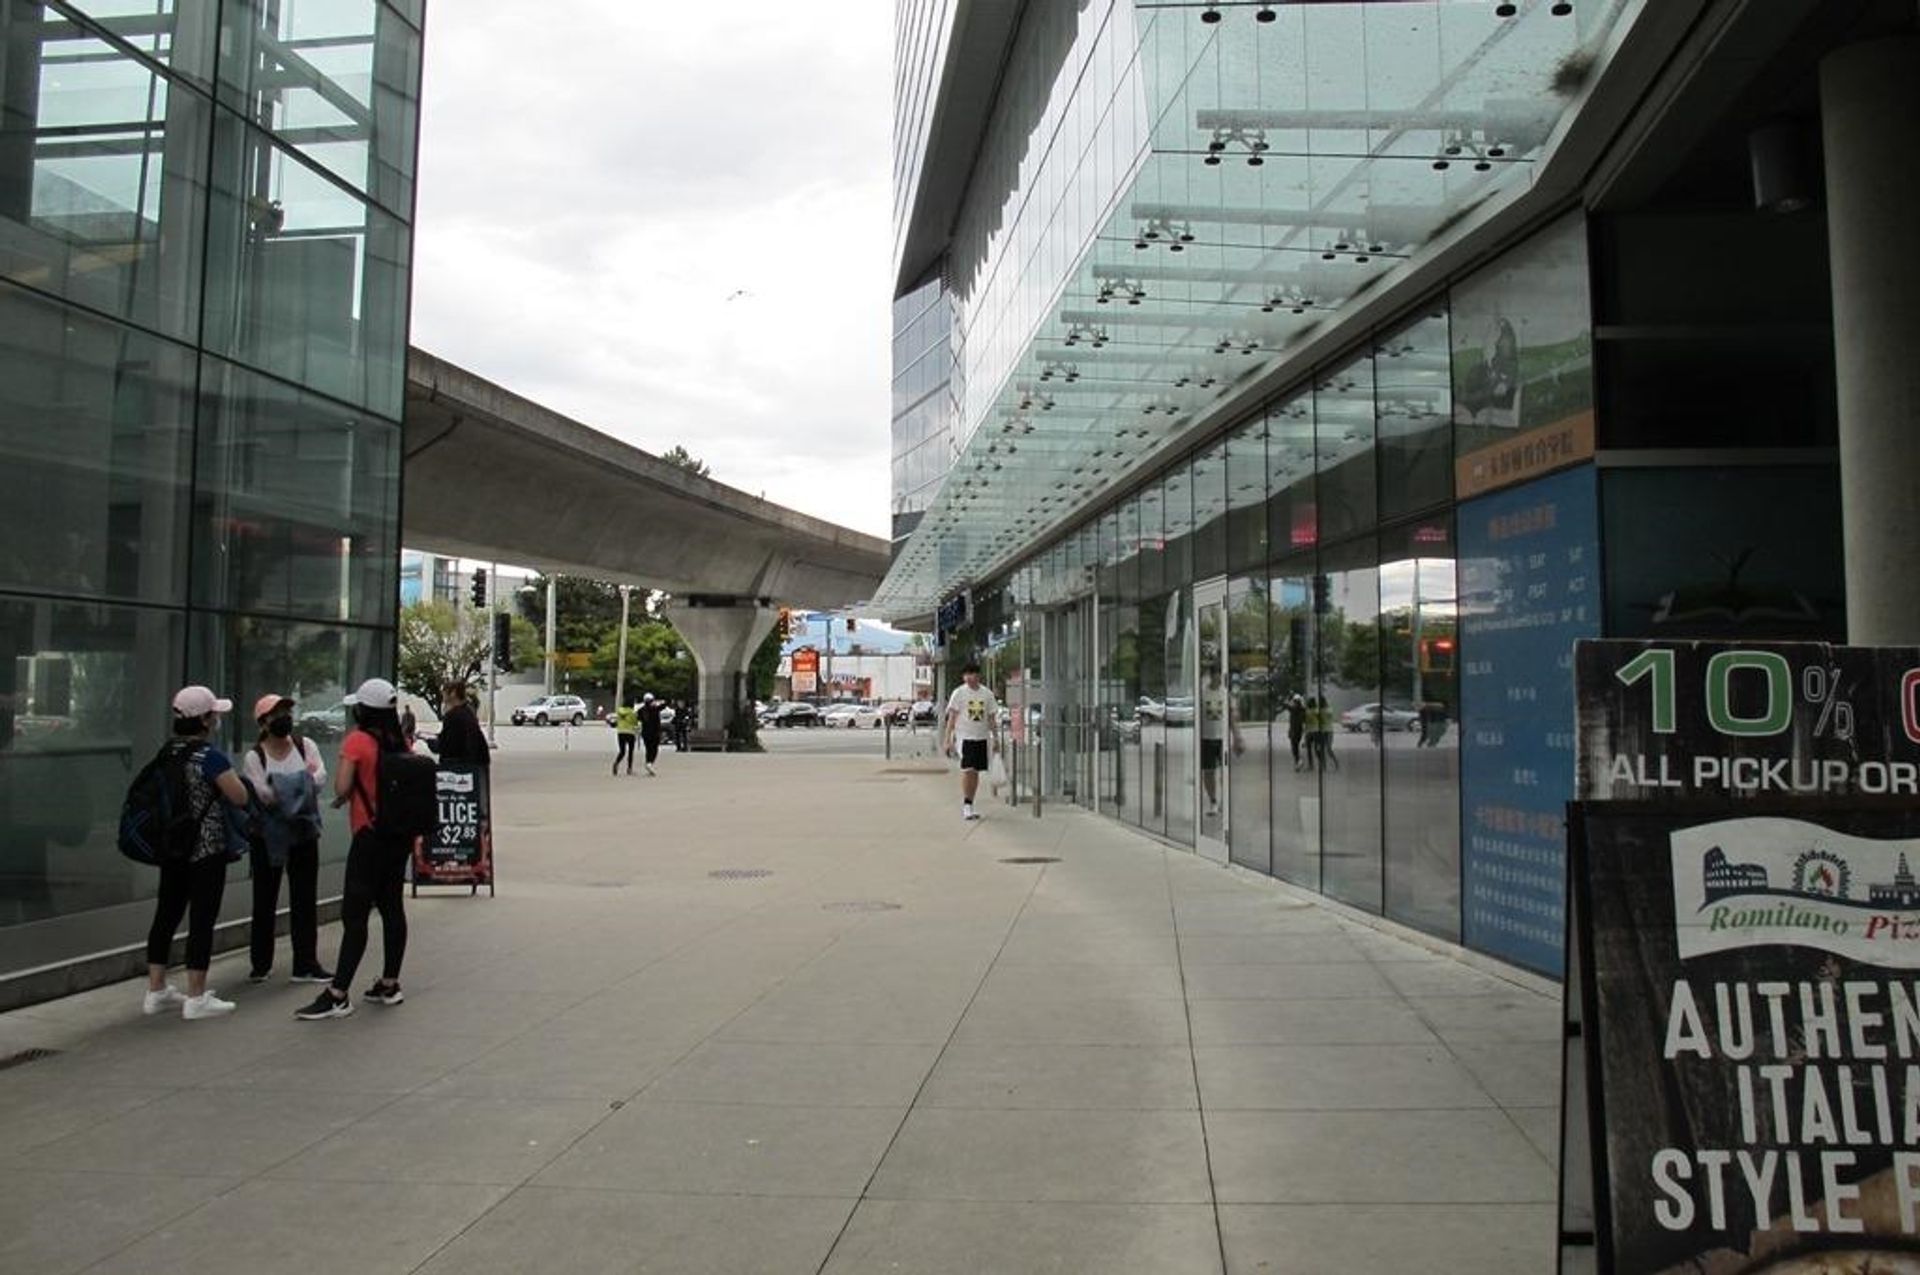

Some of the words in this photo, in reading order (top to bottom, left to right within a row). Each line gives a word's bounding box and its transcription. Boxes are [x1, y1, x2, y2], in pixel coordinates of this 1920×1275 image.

[1610, 753, 1682, 788] ALL
[1693, 756, 1850, 793] PICKUP
[1859, 763, 1920, 795] OR
[438, 802, 478, 824] LICE
[1709, 901, 1848, 936] Romilano
[1864, 914, 1920, 941] Piz
[1663, 979, 1920, 1061] AUTHEN
[1651, 1147, 1865, 1234] STYLE
